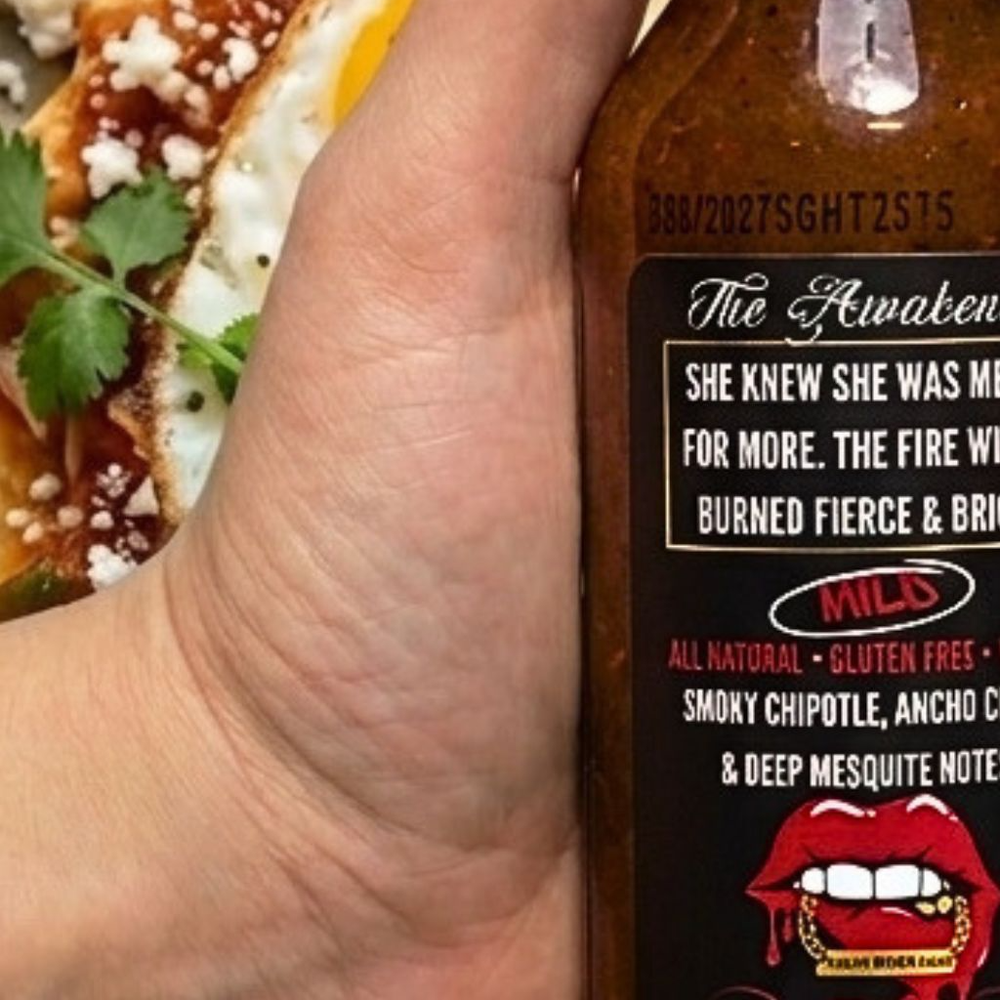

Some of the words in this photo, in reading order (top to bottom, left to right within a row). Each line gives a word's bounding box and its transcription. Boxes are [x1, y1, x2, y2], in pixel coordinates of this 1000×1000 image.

[688, 271, 770, 330] The
[685, 363, 734, 402] SHE
[742, 363, 823, 402] KNEW
[833, 363, 888, 402] SHE
[896, 360, 961, 401] WAS
[683, 428, 729, 469] FOR
[738, 430, 826, 470] MORE.
[833, 429, 888, 470] THE
[898, 428, 959, 469] FIRE
[699, 496, 804, 537] BURNED
[815, 496, 912, 537] FIERCE
[923, 496, 944, 535] &
[819, 573, 940, 624] MILD
[667, 638, 703, 672] ALL
[829, 642, 916, 675] GLUTEN
[683, 689, 758, 725] SMOKY
[765, 691, 888, 730] CHIPOTLE,
[895, 687, 976, 725] ANCHO
[721, 752, 739, 786] &
[745, 753, 804, 787] DEEP
[810, 751, 934, 792] MESQUITE
